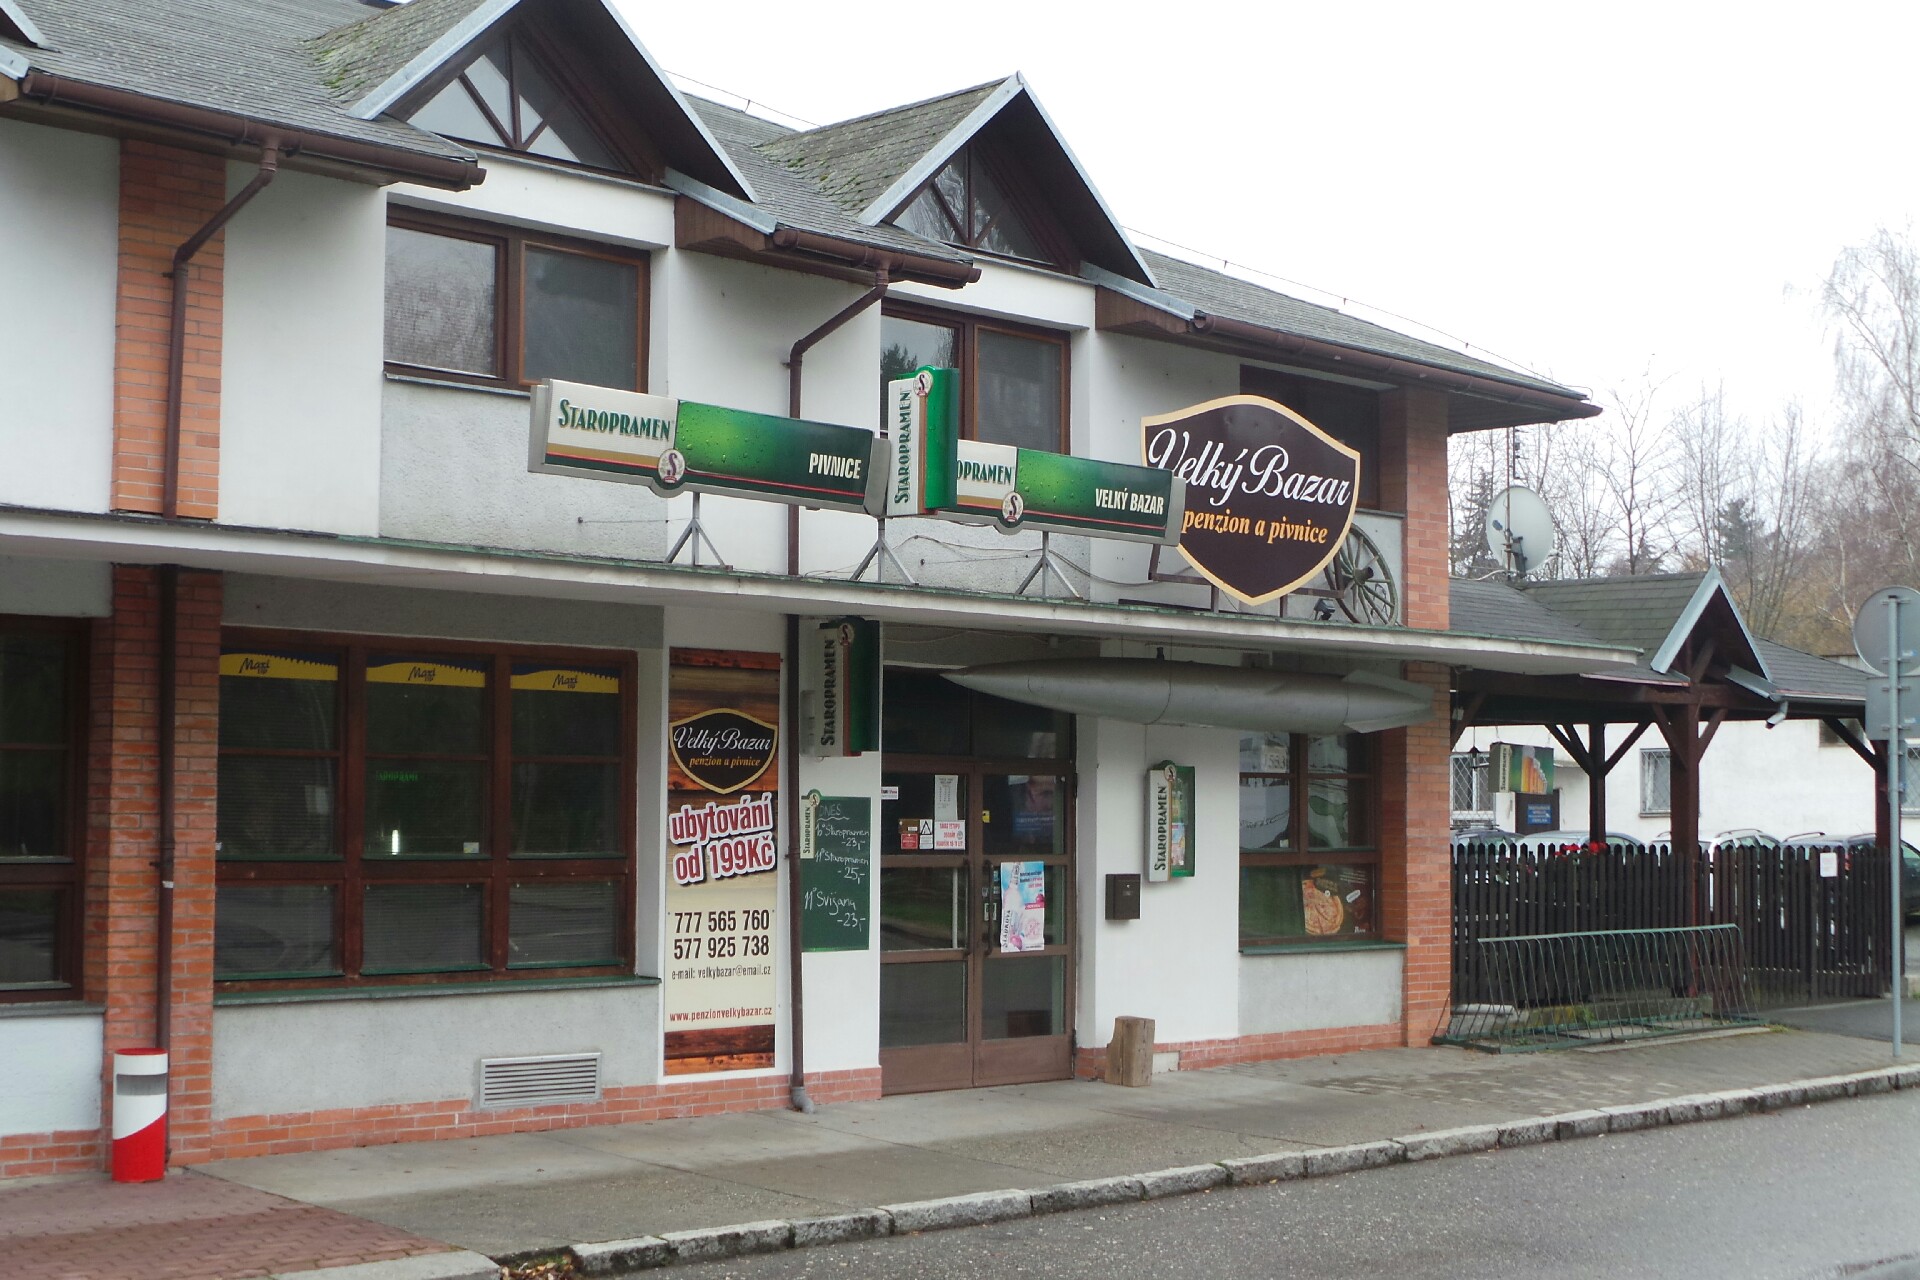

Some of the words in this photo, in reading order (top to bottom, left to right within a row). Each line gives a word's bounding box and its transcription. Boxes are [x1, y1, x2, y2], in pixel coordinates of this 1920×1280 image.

[558, 399, 671, 442] STAROPRAMEN
[894, 390, 911, 504] STAROPRAMEN
[808, 452, 862, 480] PIVNICE
[1149, 428, 1249, 506] Velký
[1241, 444, 1351, 506] Bazar
[1095, 487, 1129, 511] VELKÝ
[1129, 494, 1165, 516] BAZAR
[1181, 508, 1250, 535] penzion
[1254, 519, 1266, 537] a
[1267, 515, 1329, 544] pivnice
[821, 640, 836, 746] STAROPRAMEN
[673, 726, 721, 756] Velký
[717, 727, 771, 750] Bazar
[689, 755, 722, 769] penzion
[723, 758, 730, 766] a
[730, 756, 761, 769] pivnice
[671, 795, 770, 842] ubytování
[819, 804, 841, 817] DNES
[803, 806, 811, 854] STAROPRAMEN
[1154, 785, 1168, 871] STAROPRAMEN
[675, 847, 701, 880] od
[709, 834, 773, 875] 199Kč
[674, 911, 702, 934] 777
[707, 910, 737, 933] 565
[742, 909, 770, 931] 760
[673, 937, 702, 960] 577
[707, 936, 737, 959] 925
[742, 934, 770, 957] 738
[671, 967, 696, 980] e-mail:
[697, 963, 771, 980] velkybazar@email.cz
[669, 1006, 773, 1023] www.penzionvelkybazar.cz
